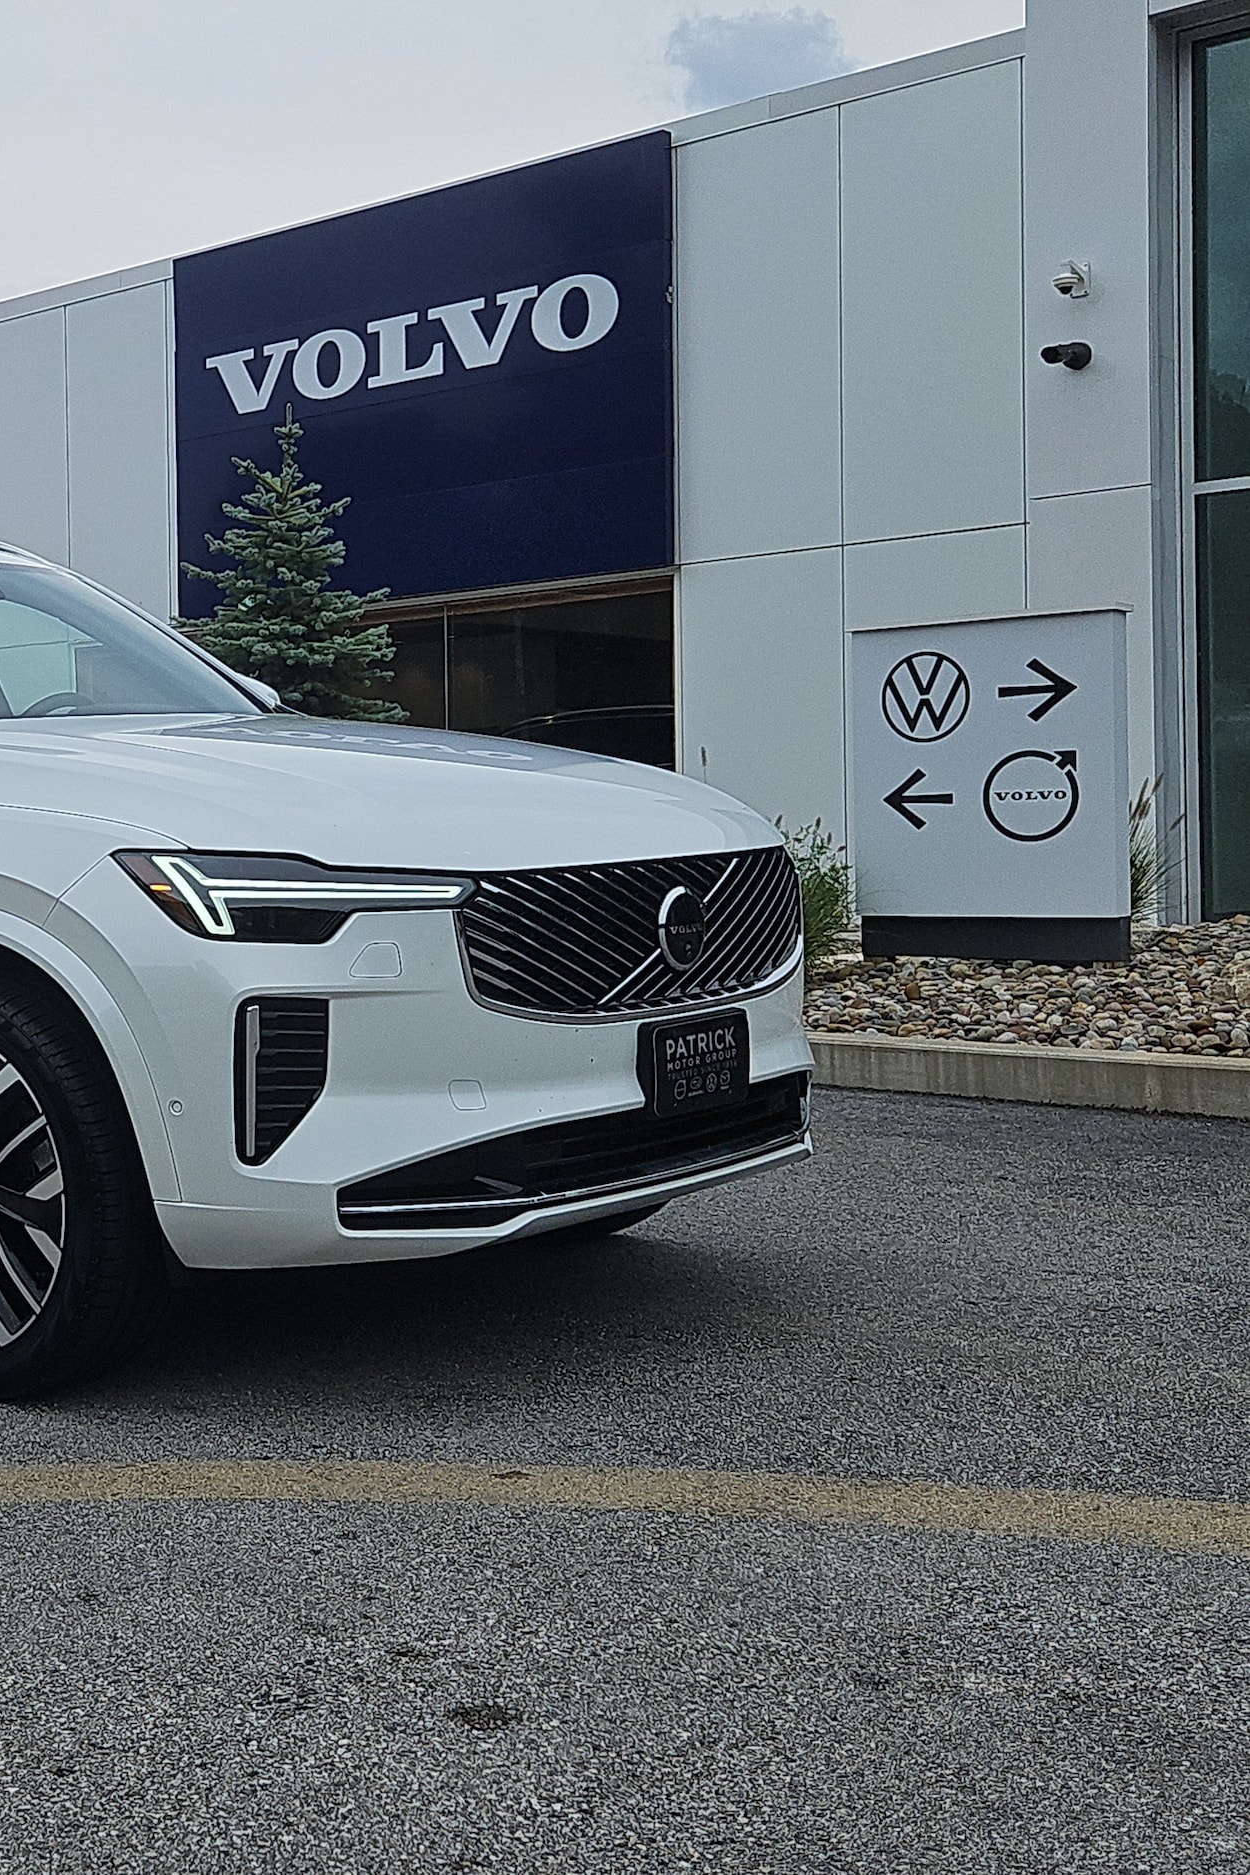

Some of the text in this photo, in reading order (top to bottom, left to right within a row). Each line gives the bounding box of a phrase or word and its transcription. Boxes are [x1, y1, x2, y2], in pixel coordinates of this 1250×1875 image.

[205, 273, 620, 415] VOLVO
[994, 789, 1068, 802] VOLVO
[666, 1026, 736, 1060] PATRICK
[667, 1048, 737, 1072] MOTOR GROUP
